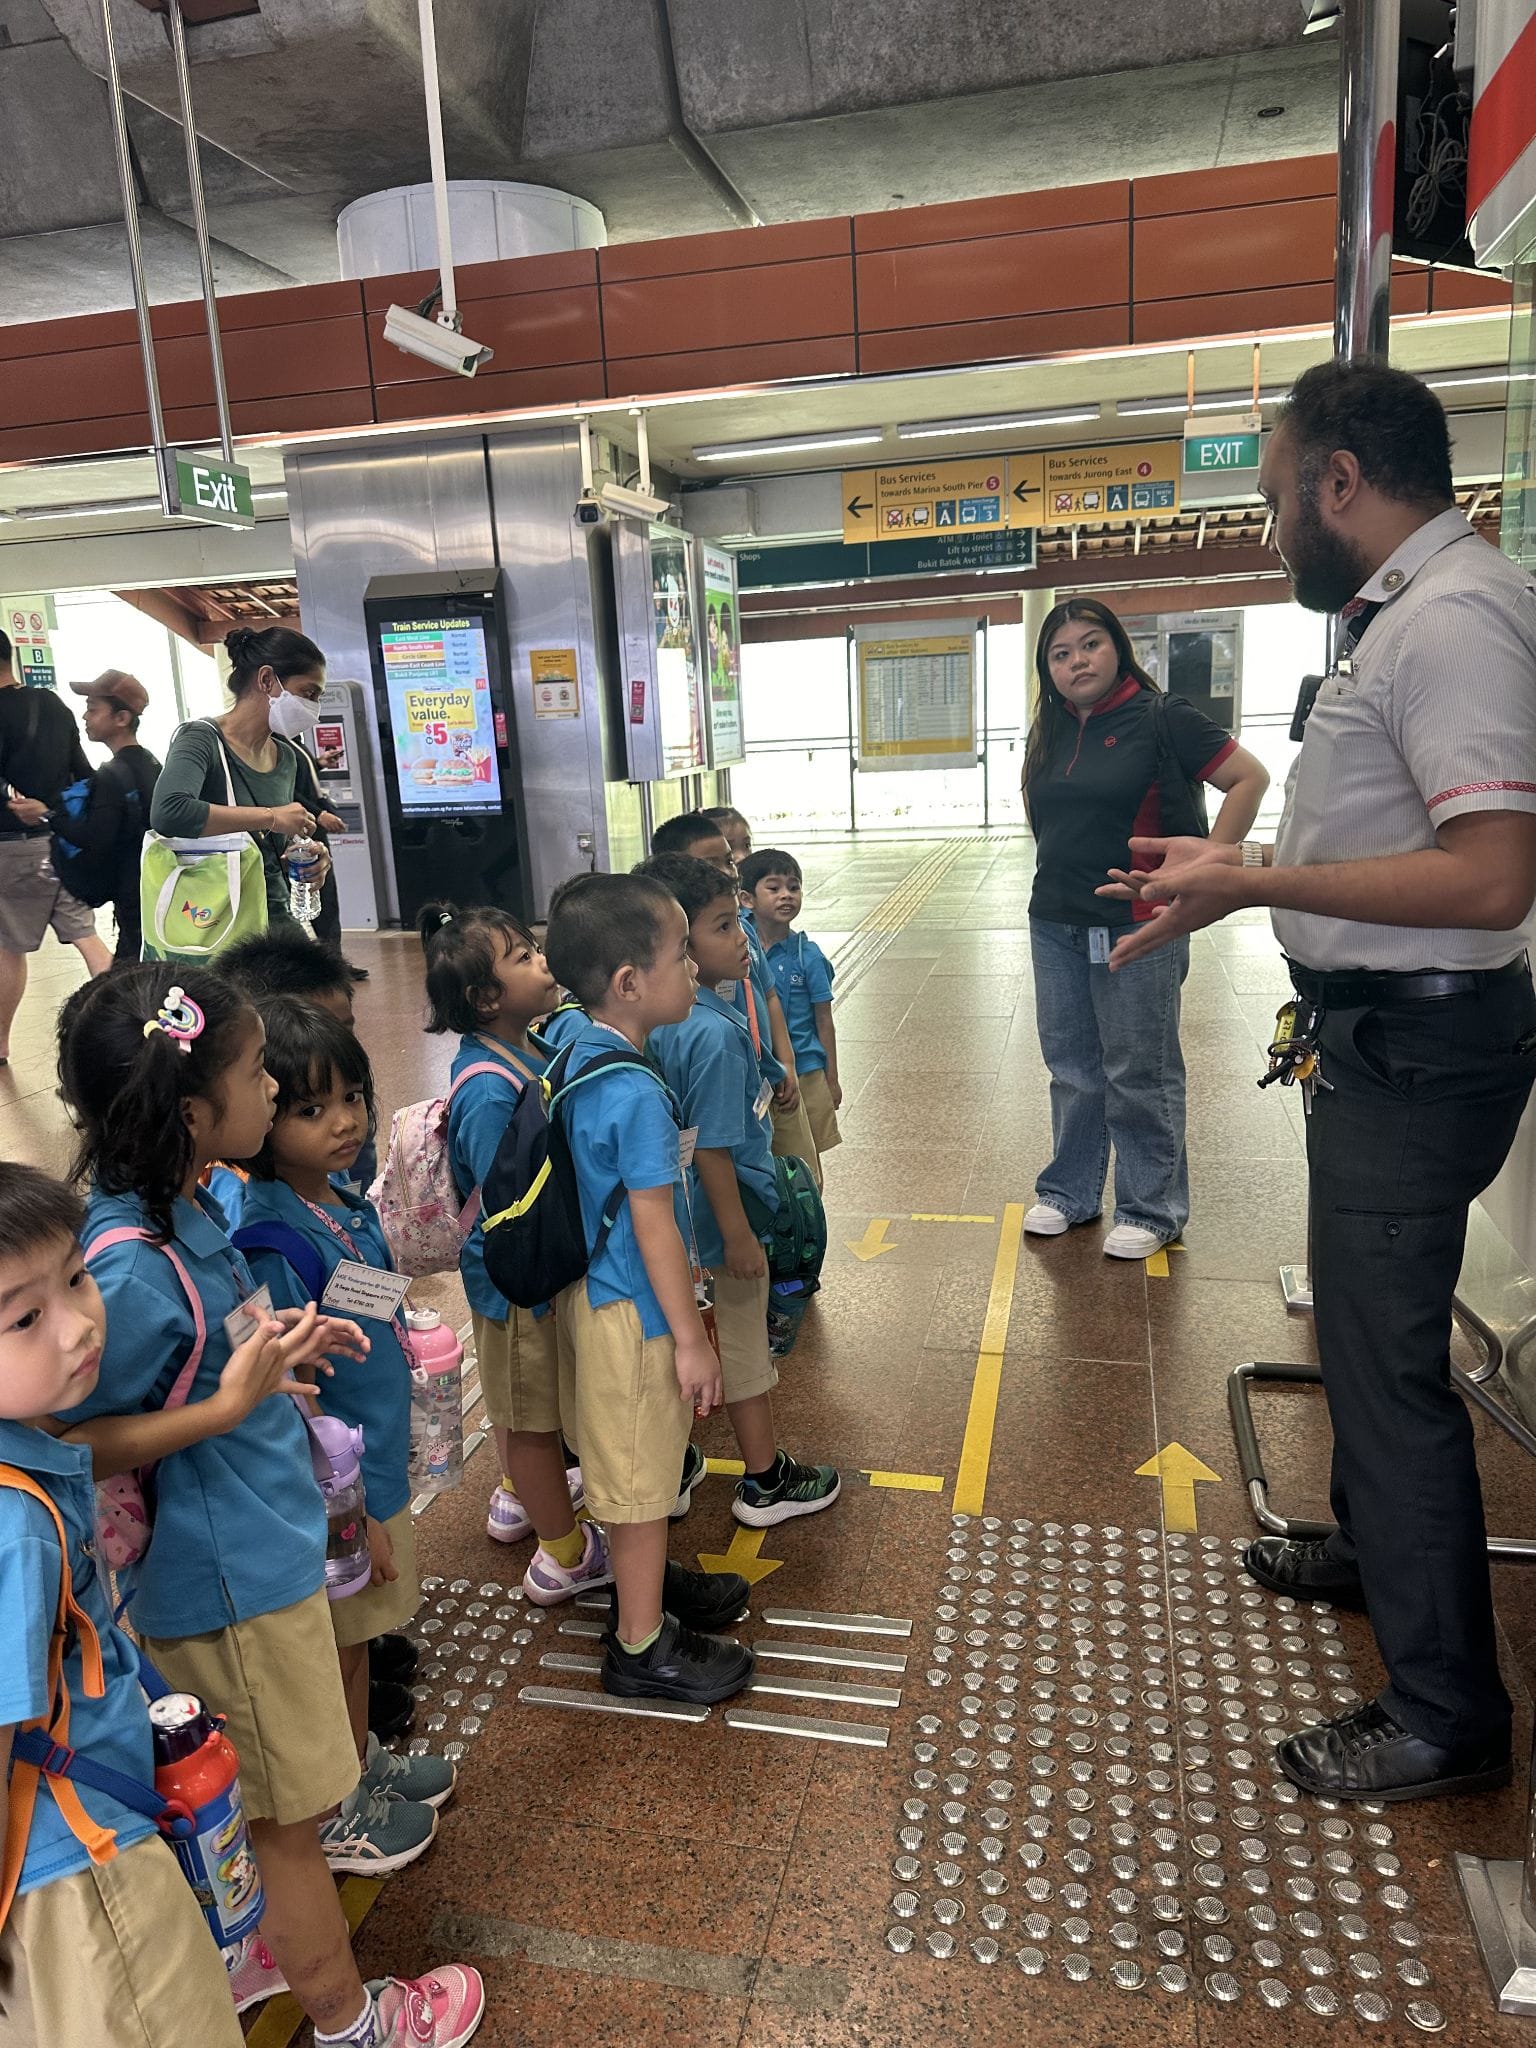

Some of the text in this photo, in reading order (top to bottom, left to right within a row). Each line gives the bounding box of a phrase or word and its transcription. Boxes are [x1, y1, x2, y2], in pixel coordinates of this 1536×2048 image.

[1200, 441, 1243, 466] EXIT
[1049, 456, 1108, 469] Bus Services
[880, 473, 936, 485] Bus Services
[1050, 473, 1081, 481] towards
[1084, 470, 1113, 479] Jurong
[1115, 468, 1132, 476] East
[193, 467, 238, 513] Exit
[881, 489, 911, 498] towards
[943, 483, 966, 492] South
[1111, 494, 1124, 510] A
[1161, 496, 1168, 506] 5
[940, 509, 951, 525] A
[986, 511, 993, 521] 3
[948, 546, 960, 555] Lift
[971, 544, 993, 552] street
[740, 553, 761, 562] Shops
[918, 560, 937, 569] Bukit
[940, 559, 961, 567] Batok
[392, 619, 470, 632] Train Service Updates
[35, 650, 42, 663] B
[410, 693, 470, 709] Everyday
[412, 708, 450, 720] value.
[425, 723, 448, 745] $5
